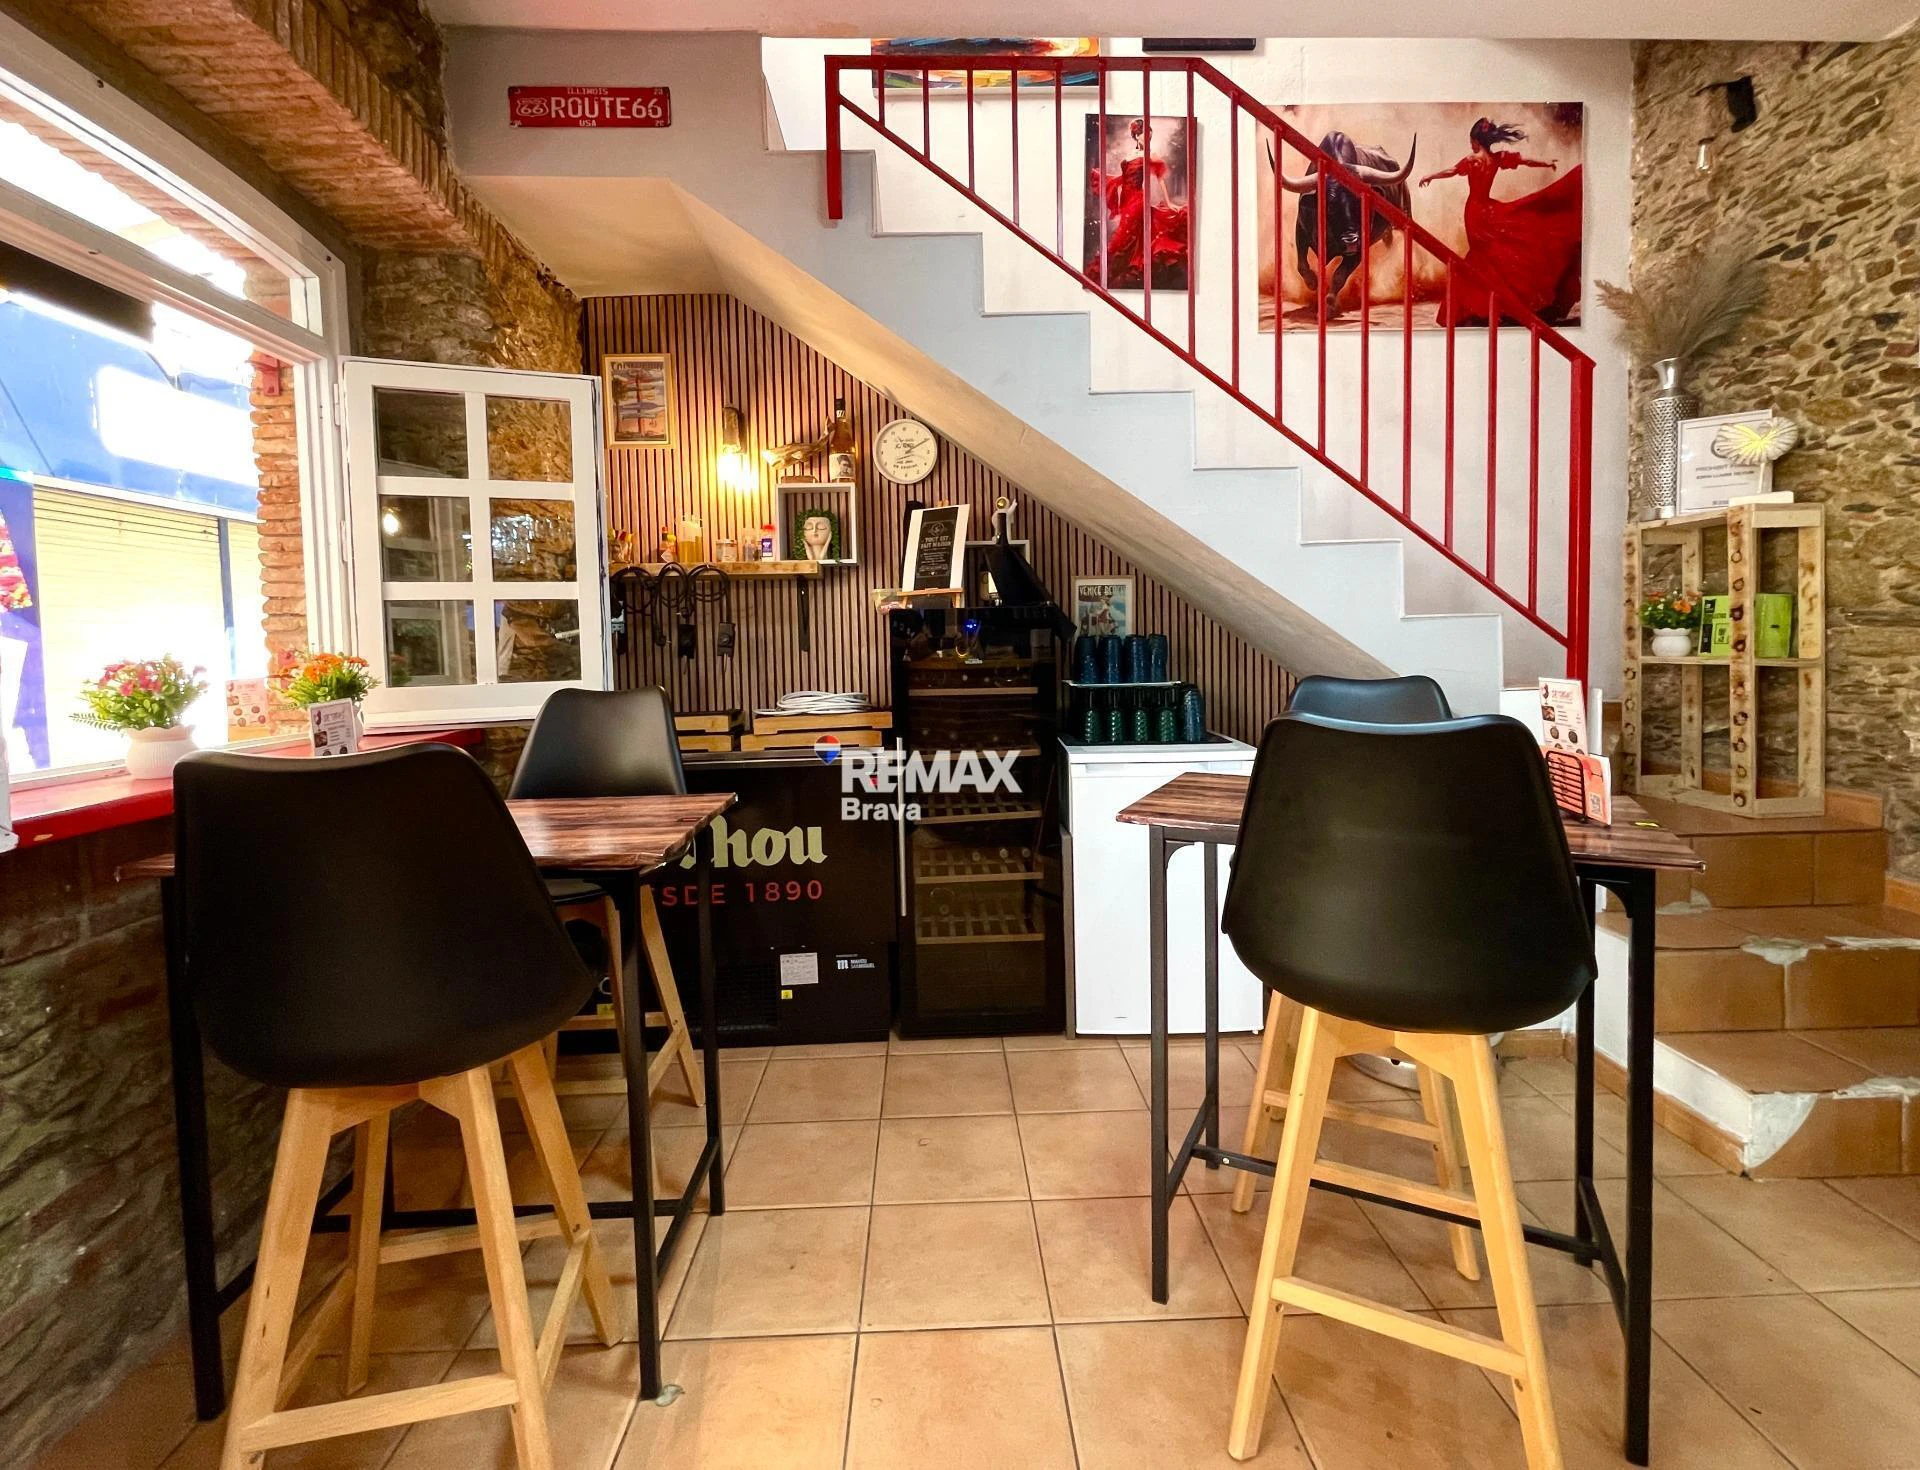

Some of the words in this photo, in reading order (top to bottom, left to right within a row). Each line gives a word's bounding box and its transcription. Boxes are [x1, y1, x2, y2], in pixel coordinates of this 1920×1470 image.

[567, 87, 609, 96] ILLINOIS
[550, 96, 663, 119] ROUTE66
[579, 119, 597, 127] USA
[745, 880, 823, 903] 1890
